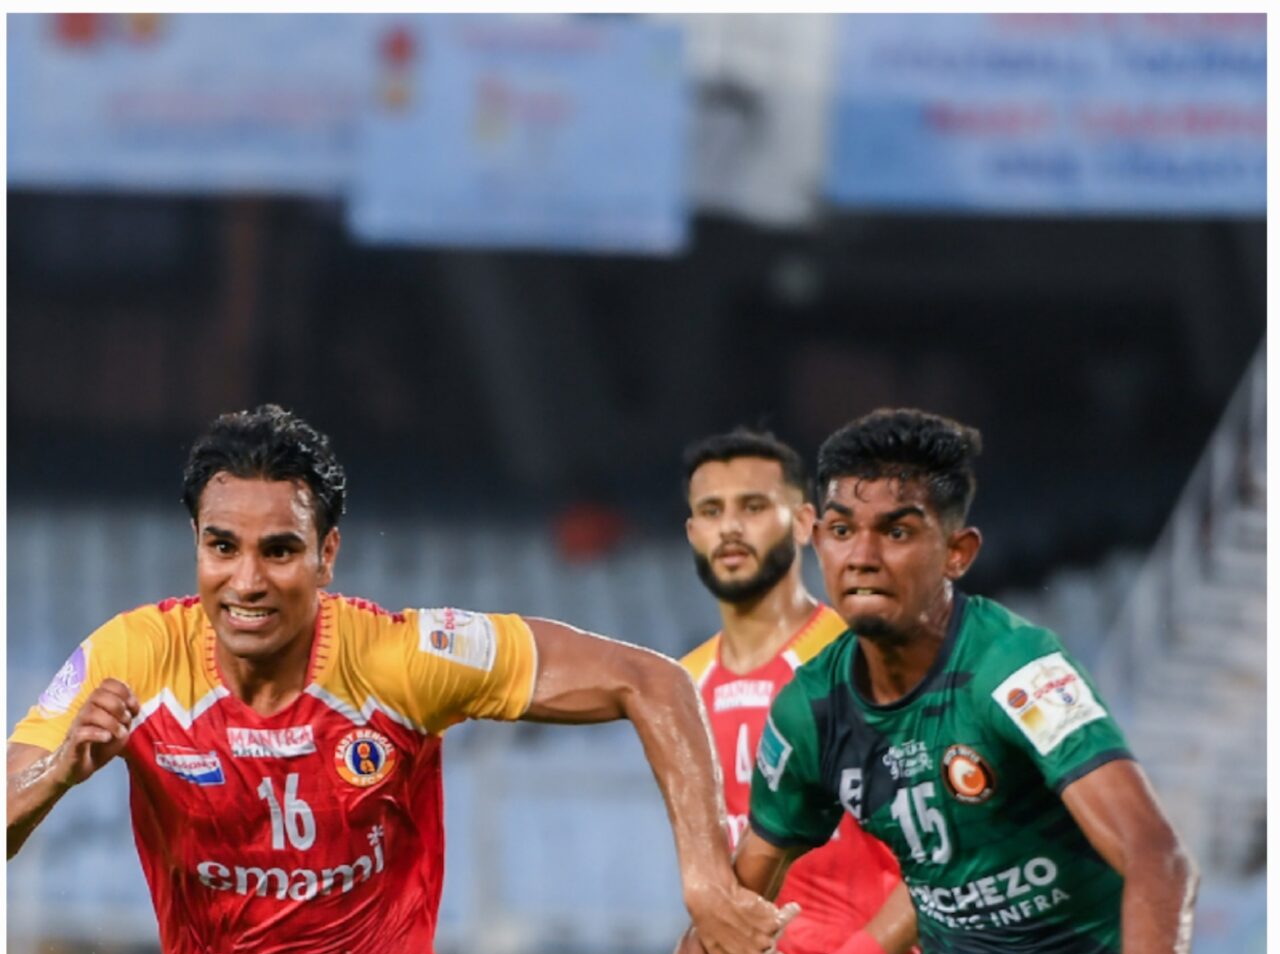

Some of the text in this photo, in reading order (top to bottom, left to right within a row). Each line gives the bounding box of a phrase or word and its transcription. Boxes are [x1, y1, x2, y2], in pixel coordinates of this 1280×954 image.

[257, 772, 316, 851] 16
[890, 781, 953, 866] 15
[196, 824, 385, 901] emami
